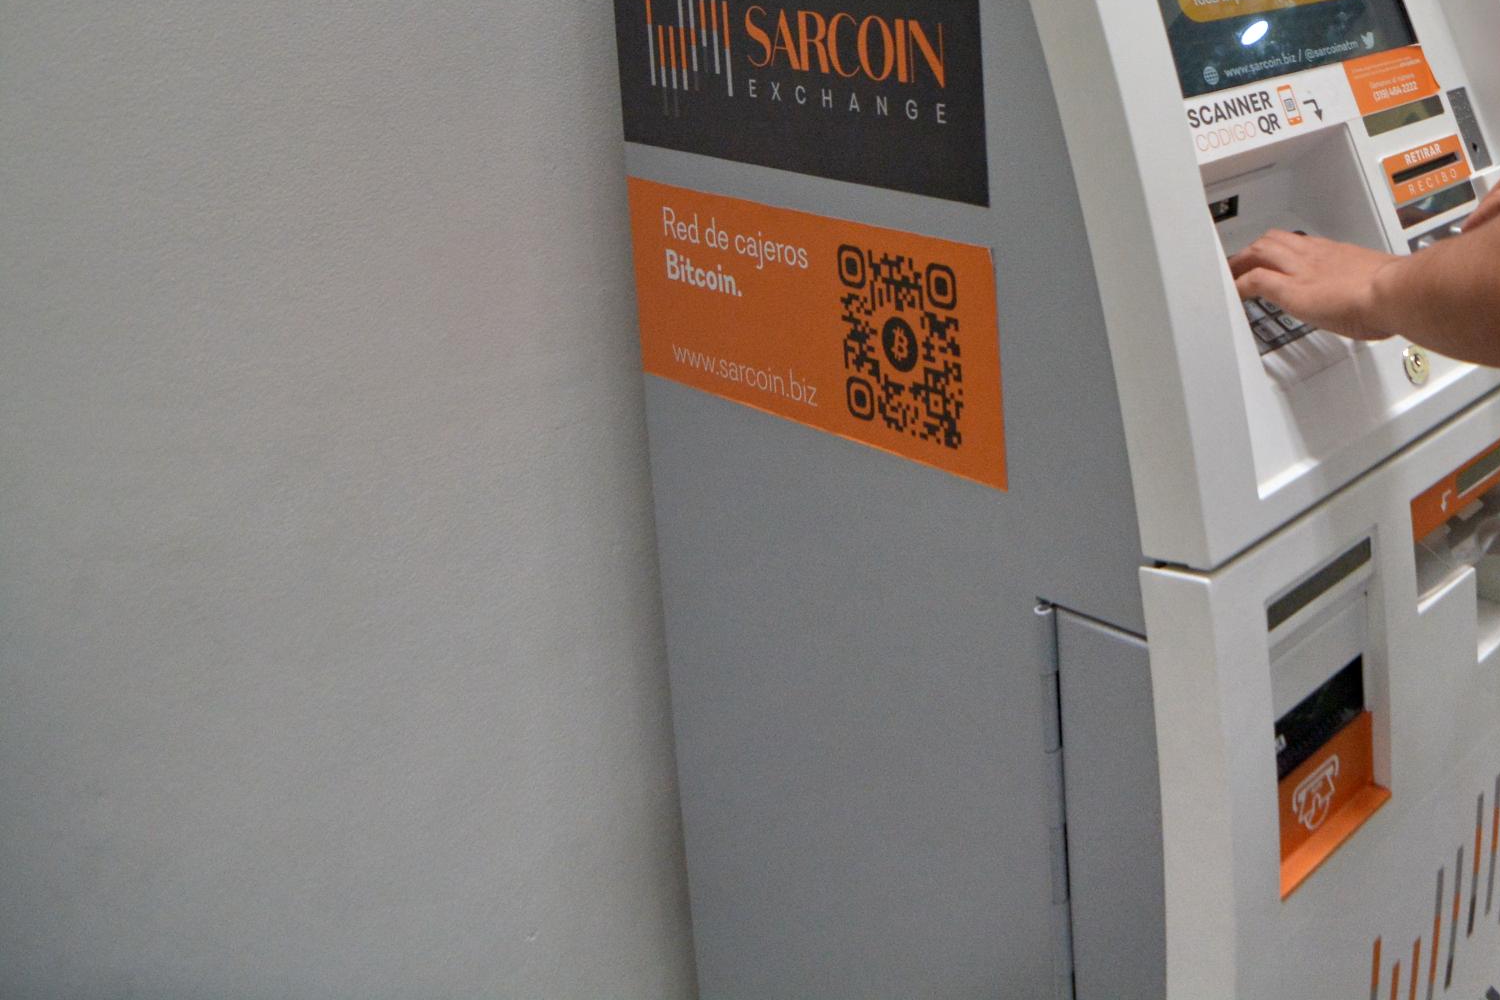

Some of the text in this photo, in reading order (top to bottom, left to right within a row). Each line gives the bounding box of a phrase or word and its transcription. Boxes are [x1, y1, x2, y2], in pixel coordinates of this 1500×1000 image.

[744, 4, 945, 88] SARCOIN
[748, 78, 948, 124] EXCHANGE
[1187, 90, 1274, 129] SCANNER
[1258, 112, 1282, 135] QR
[1404, 143, 1443, 166] RETIRAR
[1407, 168, 1457, 195] RECIBO
[662, 206, 810, 270] Red de cajeros
[664, 248, 743, 297] Bitcoin.
[671, 343, 819, 407] www.sarcoin.biz
